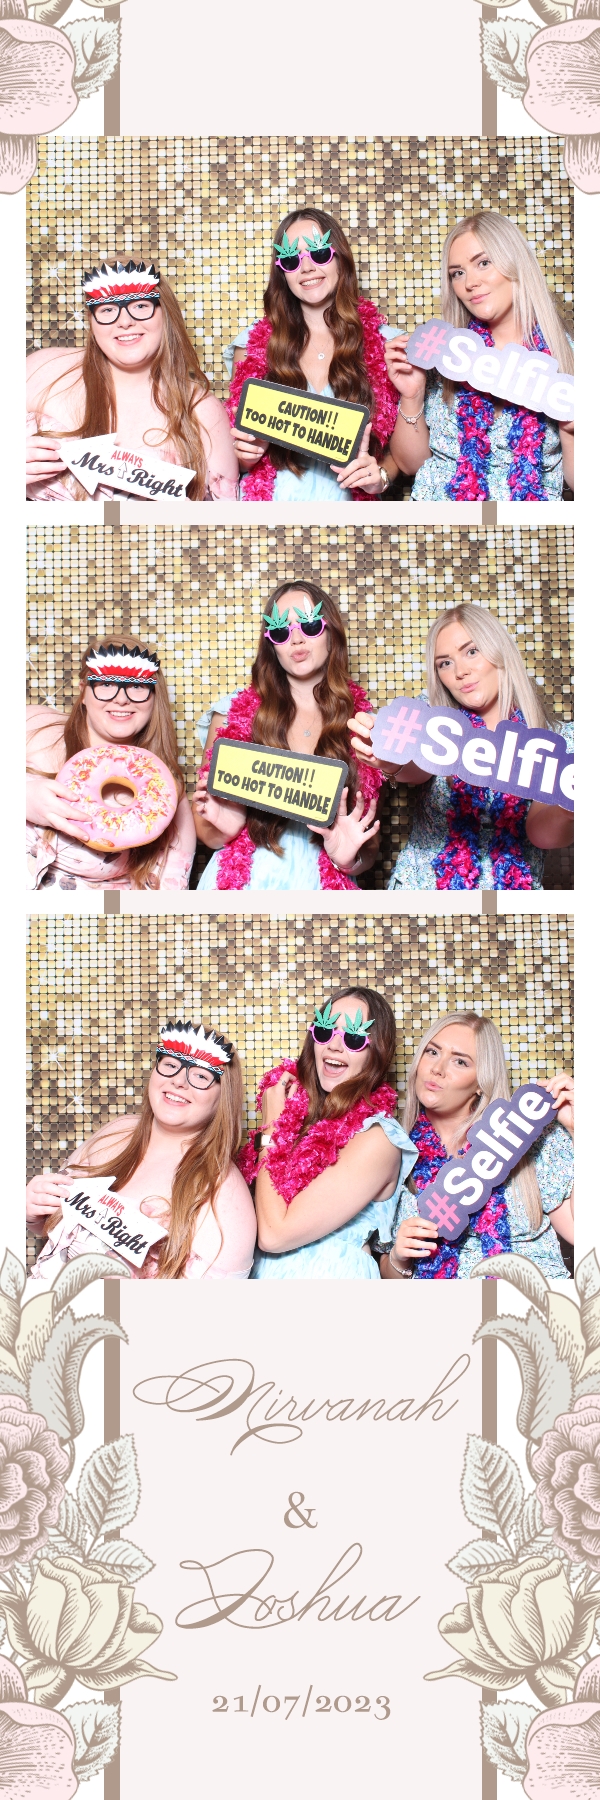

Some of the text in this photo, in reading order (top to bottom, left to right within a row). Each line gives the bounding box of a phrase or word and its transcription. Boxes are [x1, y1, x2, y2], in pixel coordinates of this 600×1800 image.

[414, 325, 574, 413] #Selfie
[245, 408, 352, 456] TOO HOT TO HANDLE
[278, 400, 339, 430] CAUTION!!
[71, 452, 184, 498] Mrs Right
[111, 450, 144, 468] ALWAYS
[217, 770, 331, 815] TOO HOT TO HANDLE
[251, 760, 316, 788] CAUTION!!
[425, 1091, 551, 1232] #Selfie
[64, 1192, 149, 1254] Mrs Right
[97, 1194, 125, 1216] ALWAYS
